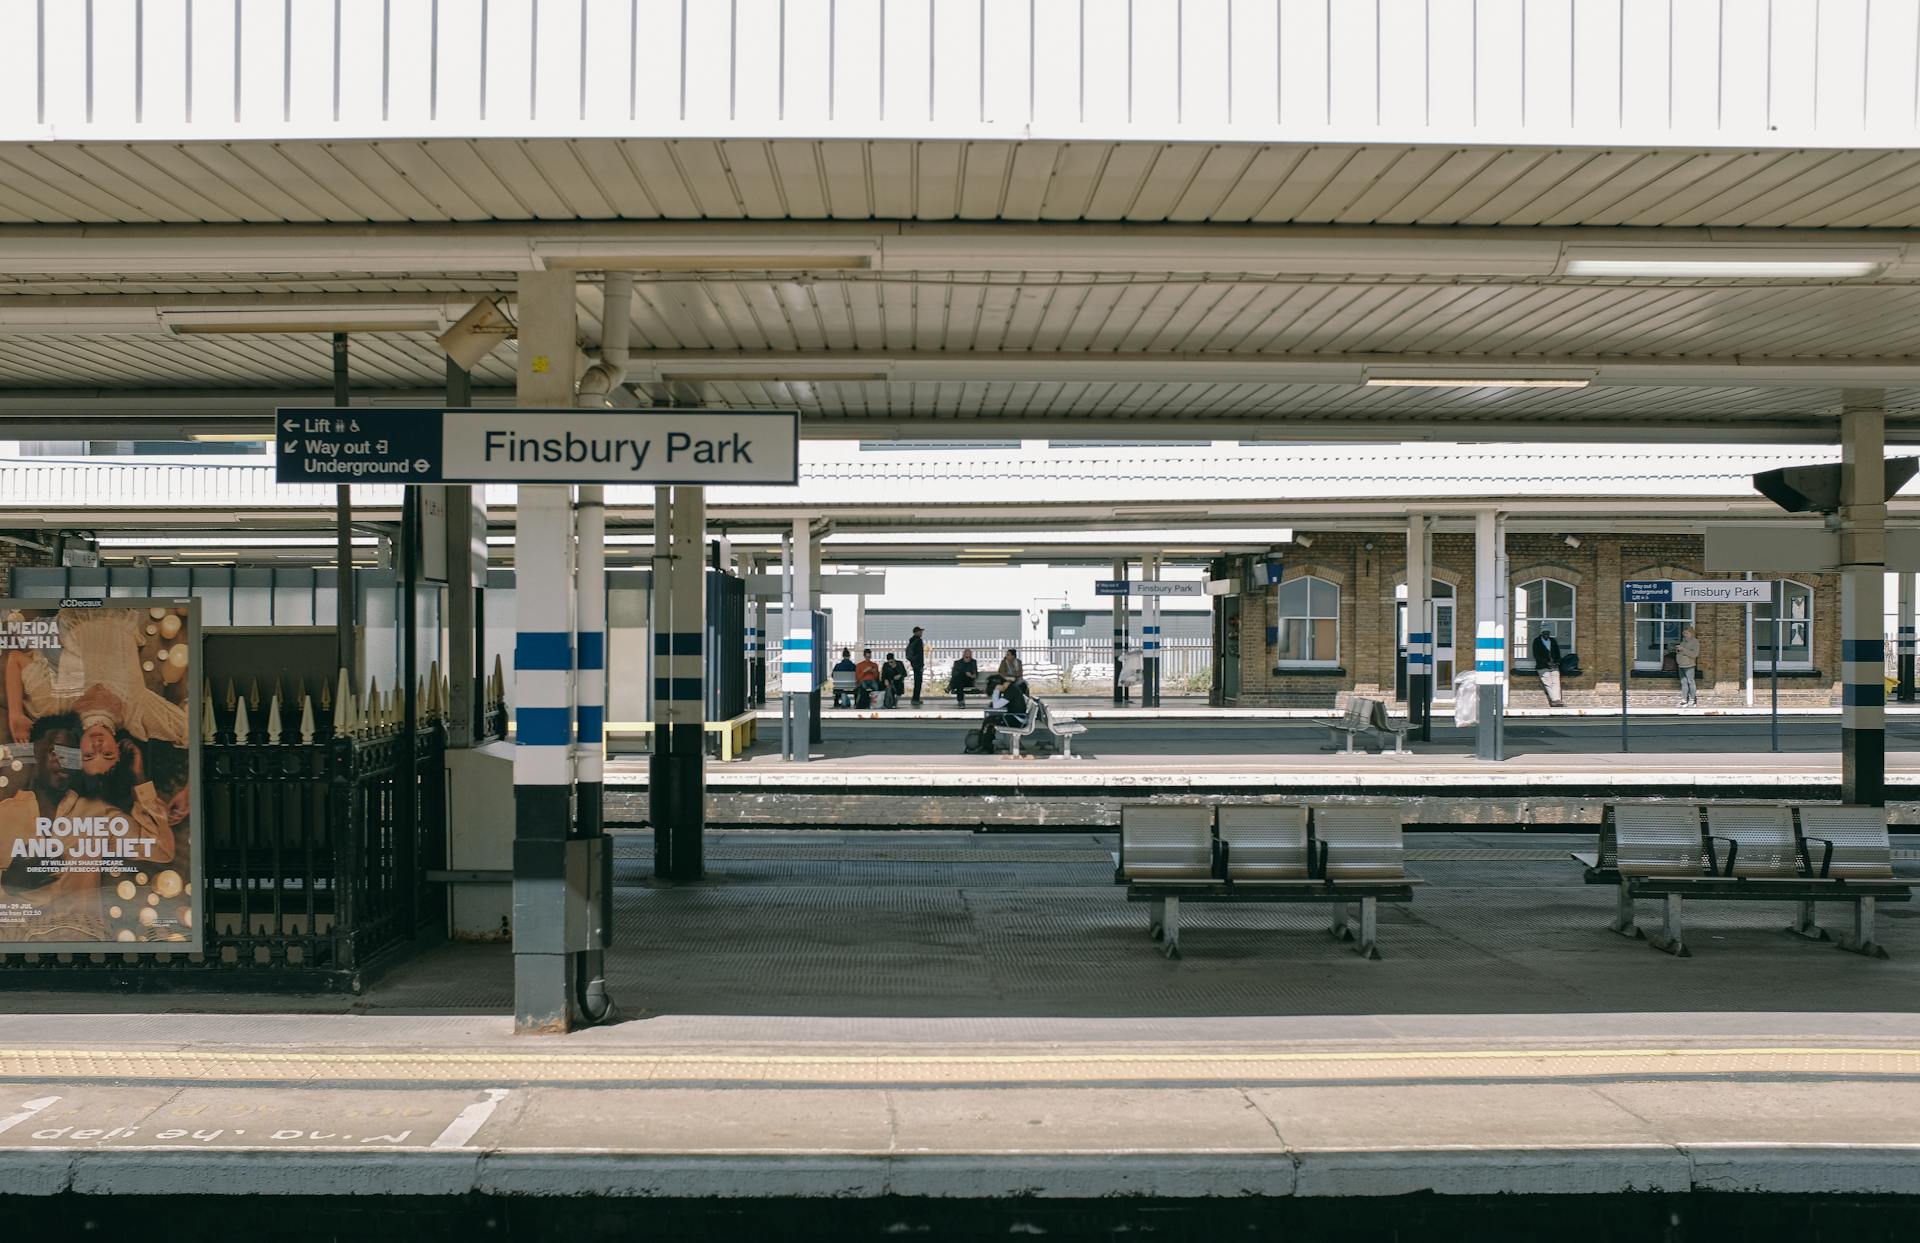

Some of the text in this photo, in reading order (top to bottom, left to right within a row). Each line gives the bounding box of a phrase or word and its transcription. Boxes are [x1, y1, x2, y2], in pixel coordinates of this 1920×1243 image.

[304, 418, 331, 433] Lift
[304, 440, 371, 457] Way out
[484, 431, 753, 471] Finsbury Park
[304, 459, 410, 476] Underground
[1137, 584, 1193, 593] Finsbury Park
[1683, 587, 1760, 599] Finsbury Park
[60, 599, 102, 607] JCDecaux
[37, 817, 129, 836] ROMEO
[11, 839, 155, 857] AND JULIET
[155, 1128, 246, 1142] he
